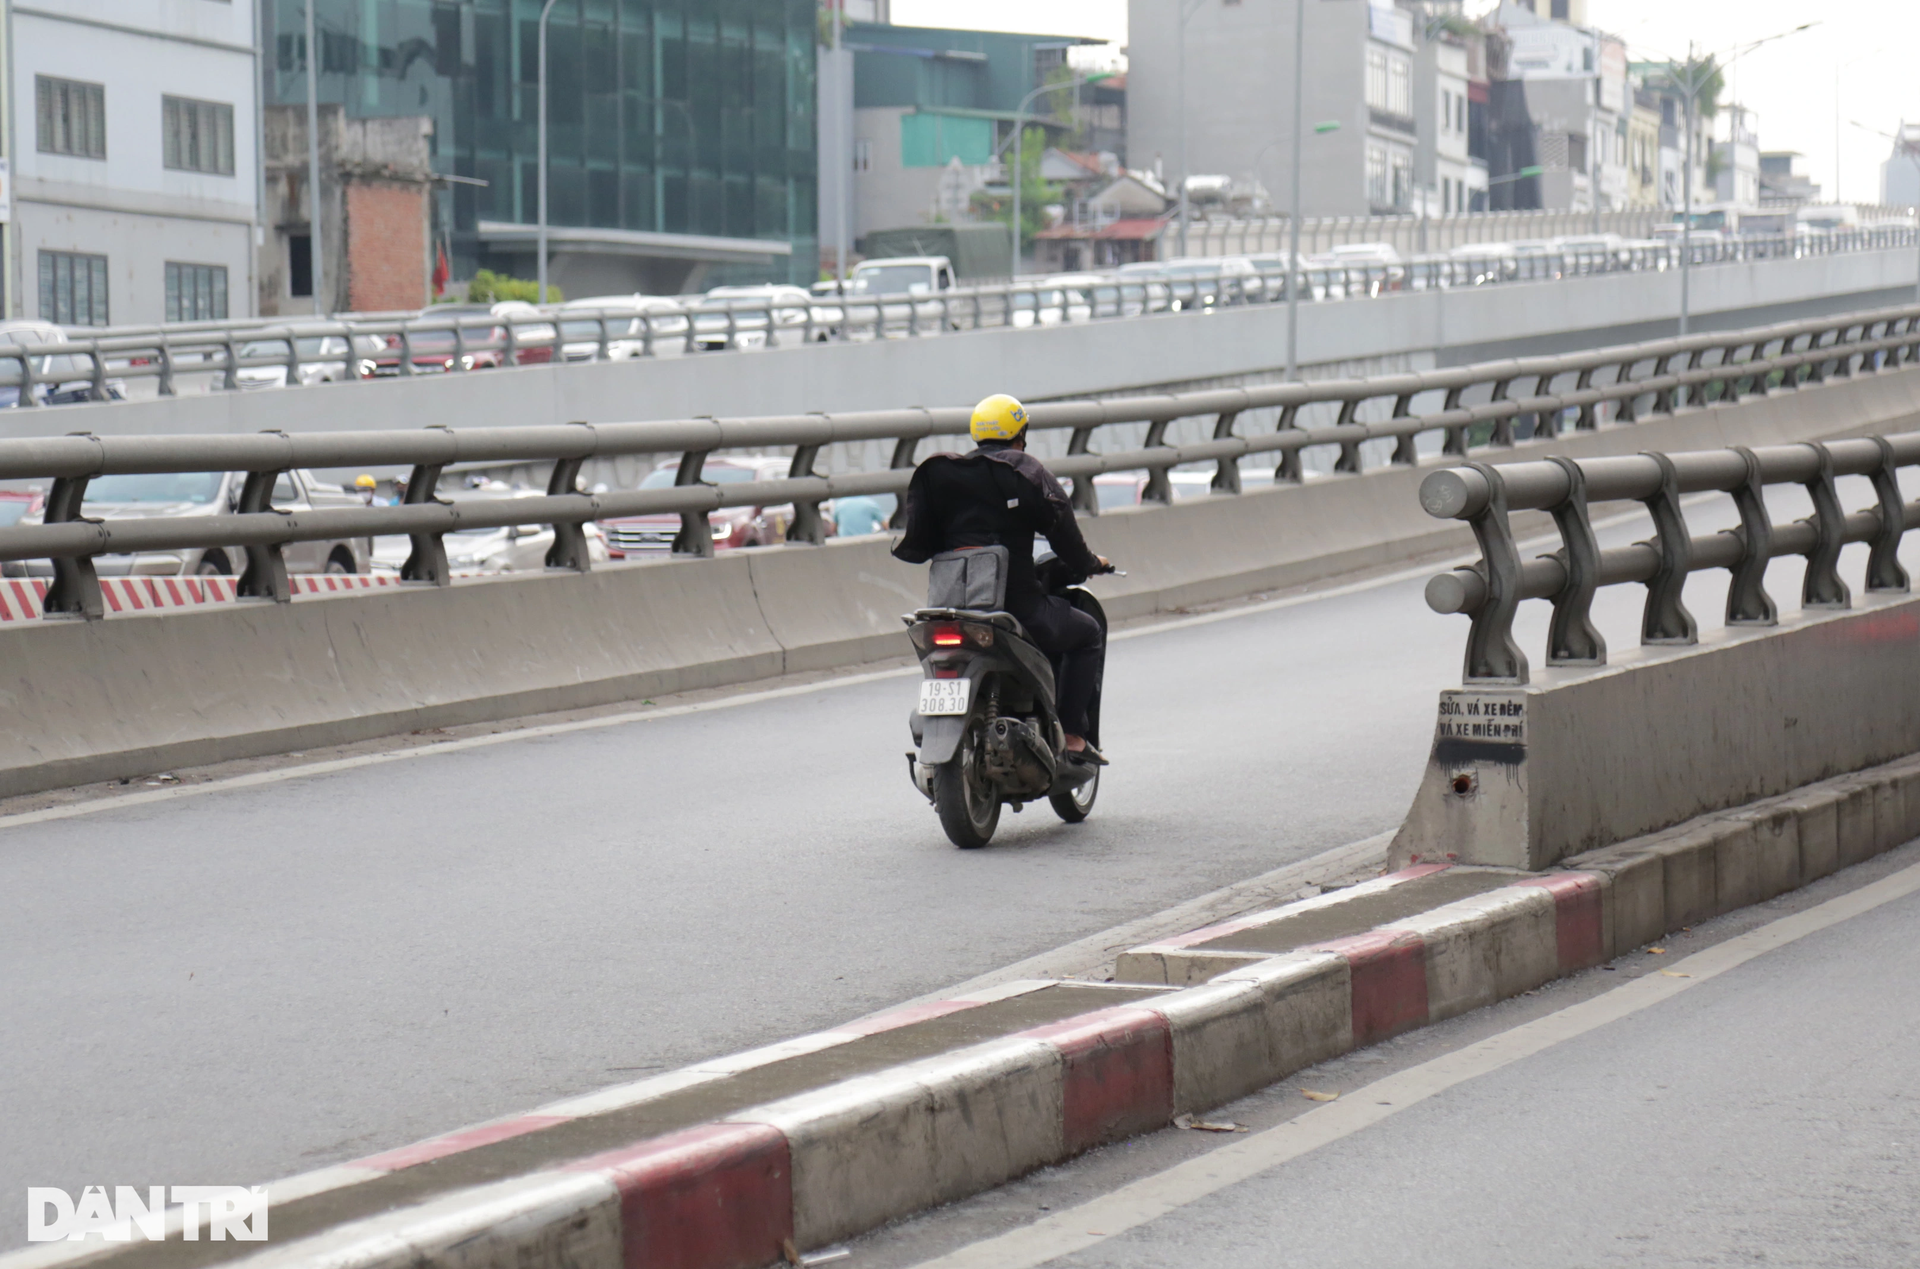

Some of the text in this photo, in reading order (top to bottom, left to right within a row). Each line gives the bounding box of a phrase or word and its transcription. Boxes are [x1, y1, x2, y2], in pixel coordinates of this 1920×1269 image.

[920, 696, 966, 713] 308.30
[1467, 698, 1480, 716] VÁ
[1484, 703, 1497, 716] XE
[1440, 718, 1454, 736] VÁ
[1456, 723, 1469, 736] XE
